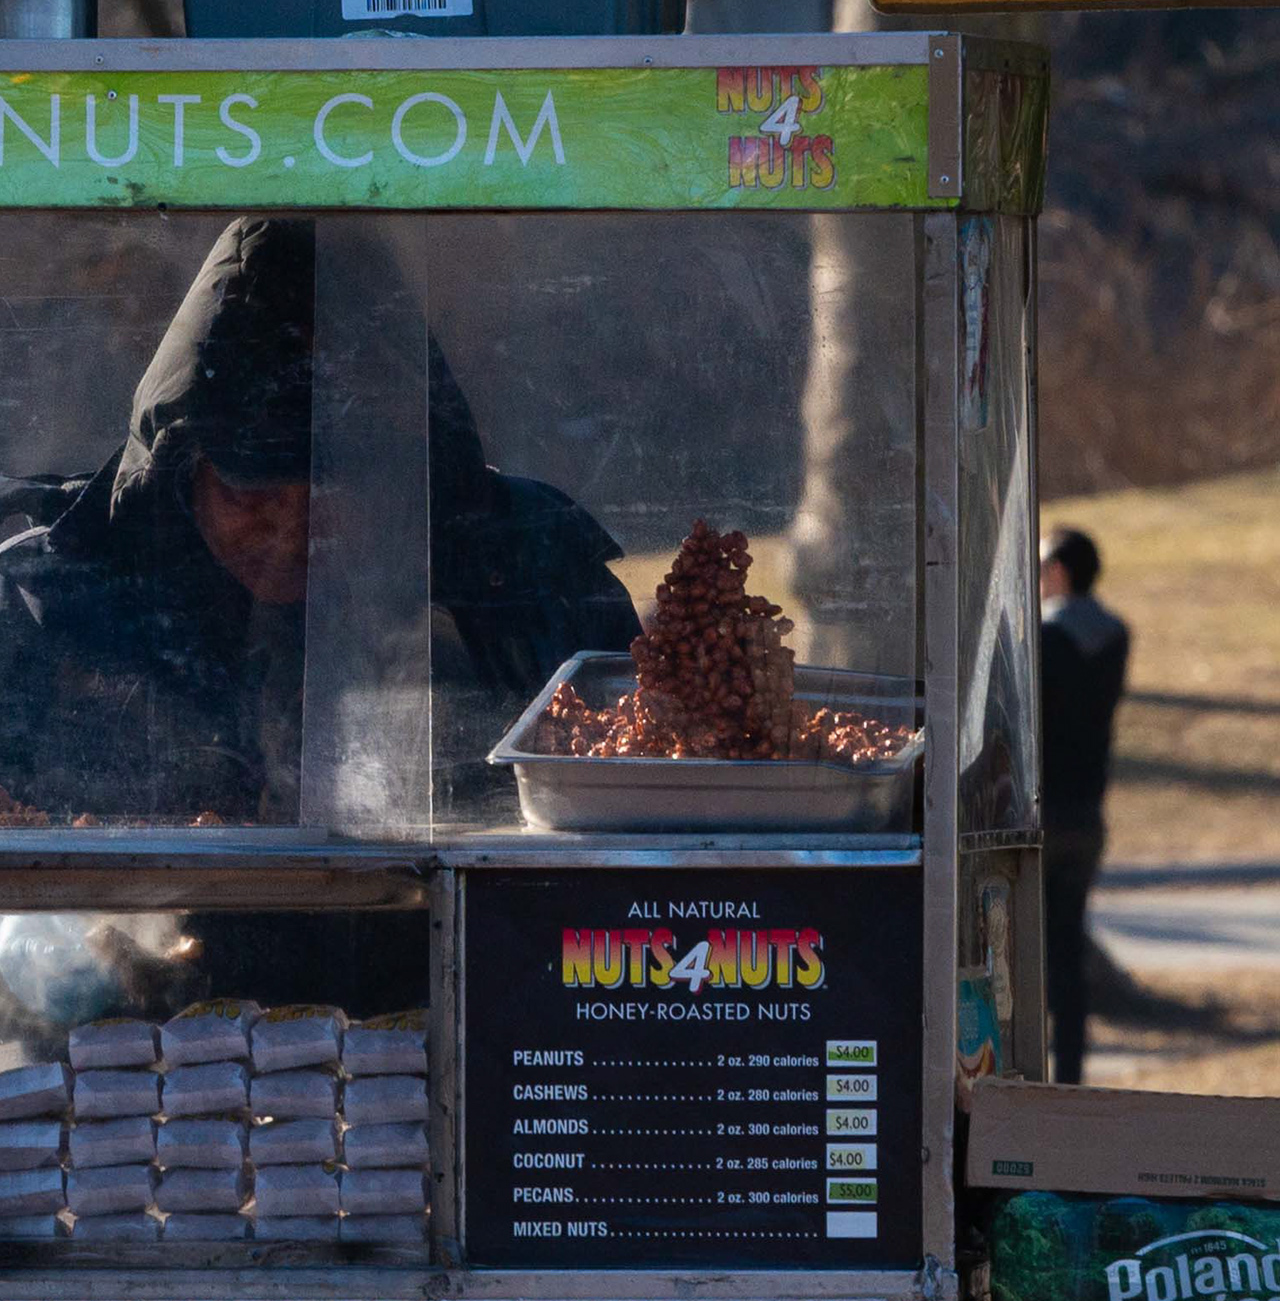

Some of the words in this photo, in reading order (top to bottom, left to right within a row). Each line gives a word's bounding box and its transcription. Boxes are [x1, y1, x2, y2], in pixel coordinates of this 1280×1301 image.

[716, 66, 825, 115] NUTS
[759, 94, 803, 148] 4
[728, 134, 837, 191] NUTS
[628, 901, 661, 919] ALL
[670, 901, 761, 919] NATURAL
[562, 927, 825, 995] NUTS4NUTS
[576, 1002, 750, 1021] HONEY-ROASTED
[758, 1003, 811, 1021] NUTS
[513, 1050, 584, 1066] PEANUTS
[717, 1054, 725, 1067] 2
[727, 1056, 745, 1067] oz.
[748, 1054, 771, 1067] 290
[773, 1054, 819, 1067] calories
[836, 1045, 869, 1058] $4.00
[513, 1084, 588, 1101] CASHEWS
[717, 1088, 725, 1101] 2
[727, 1090, 745, 1101] oz.
[748, 1089, 770, 1101] 280
[773, 1088, 819, 1101] calories
[836, 1079, 869, 1093] $4.00
[513, 1118, 589, 1135] ALMONDS
[717, 1123, 725, 1136] 2
[727, 1125, 745, 1136] oz.
[748, 1123, 770, 1135] 300
[773, 1123, 819, 1136] calories
[836, 1116, 869, 1130] $4.00
[513, 1153, 585, 1169] COCONUT
[716, 1157, 724, 1170] 2
[726, 1159, 744, 1170] oz.
[747, 1157, 769, 1170] 285
[772, 1157, 818, 1170] calories
[830, 1152, 863, 1167] $4.00
[513, 1187, 574, 1203] PECANS
[717, 1191, 725, 1204] 2
[727, 1193, 745, 1204] oz.
[748, 1191, 771, 1204] 300
[773, 1191, 819, 1204] calories
[513, 1221, 562, 1237] MIXED
[567, 1221, 608, 1237] NUTS
